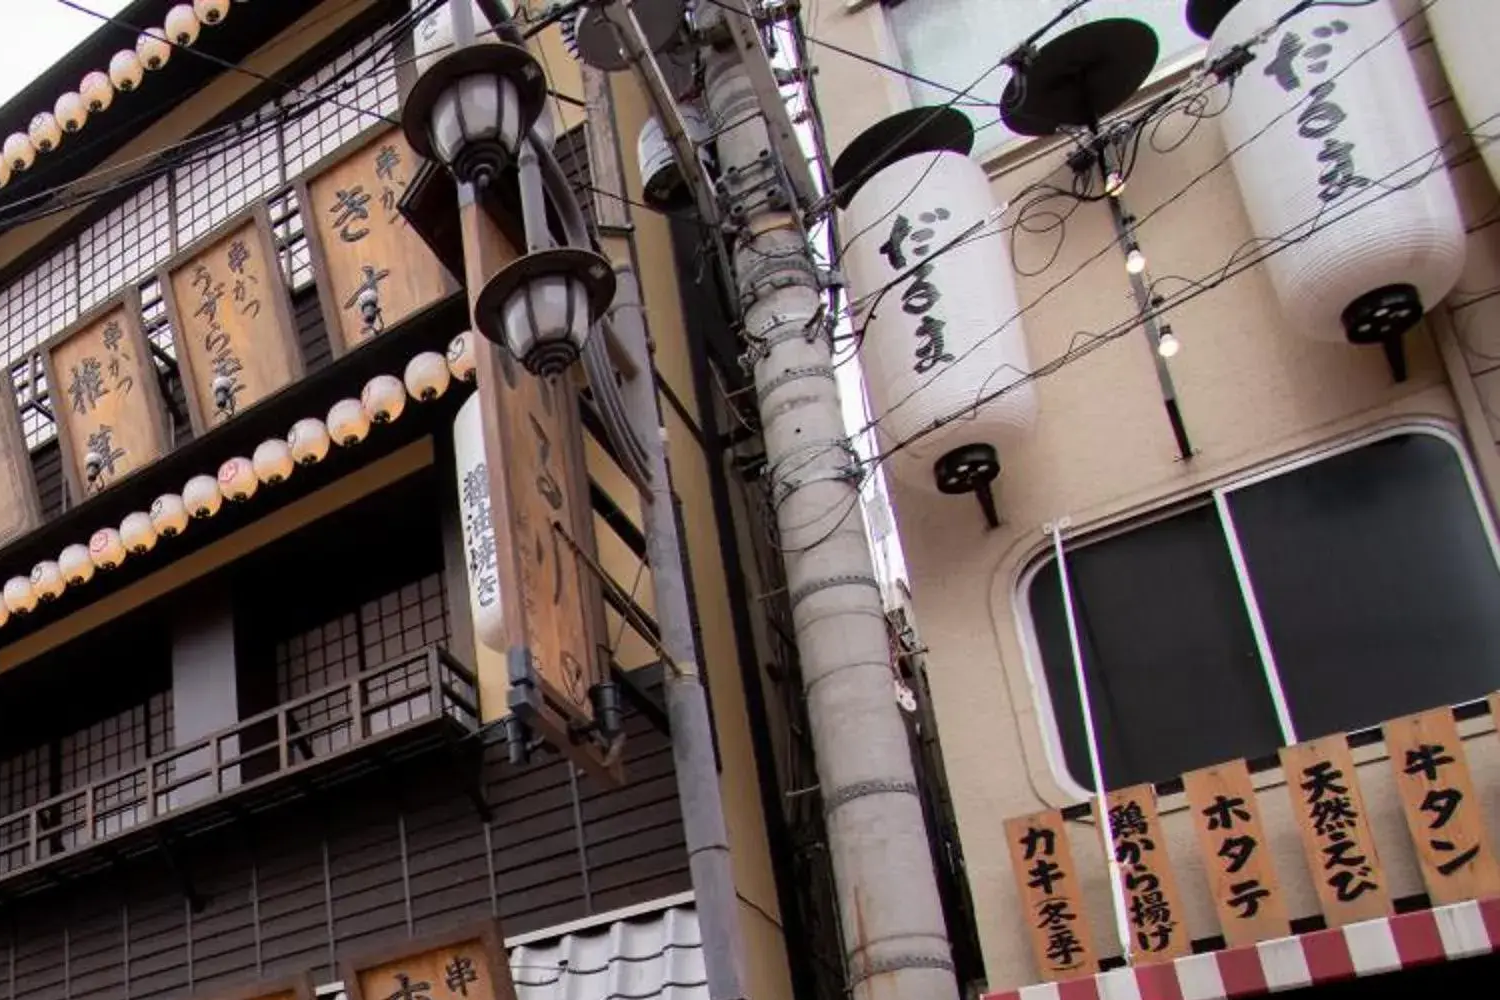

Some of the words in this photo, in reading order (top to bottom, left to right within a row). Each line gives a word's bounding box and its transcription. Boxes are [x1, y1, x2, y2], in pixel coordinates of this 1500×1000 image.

[1264, 20, 1369, 201] だるま
[880, 207, 954, 374] だるま
[1108, 802, 1178, 952] 鶏から揚げ
[1203, 796, 1270, 919] ホタテ
[1301, 761, 1379, 902] 天然えび
[1404, 744, 1480, 877] 牛タン
